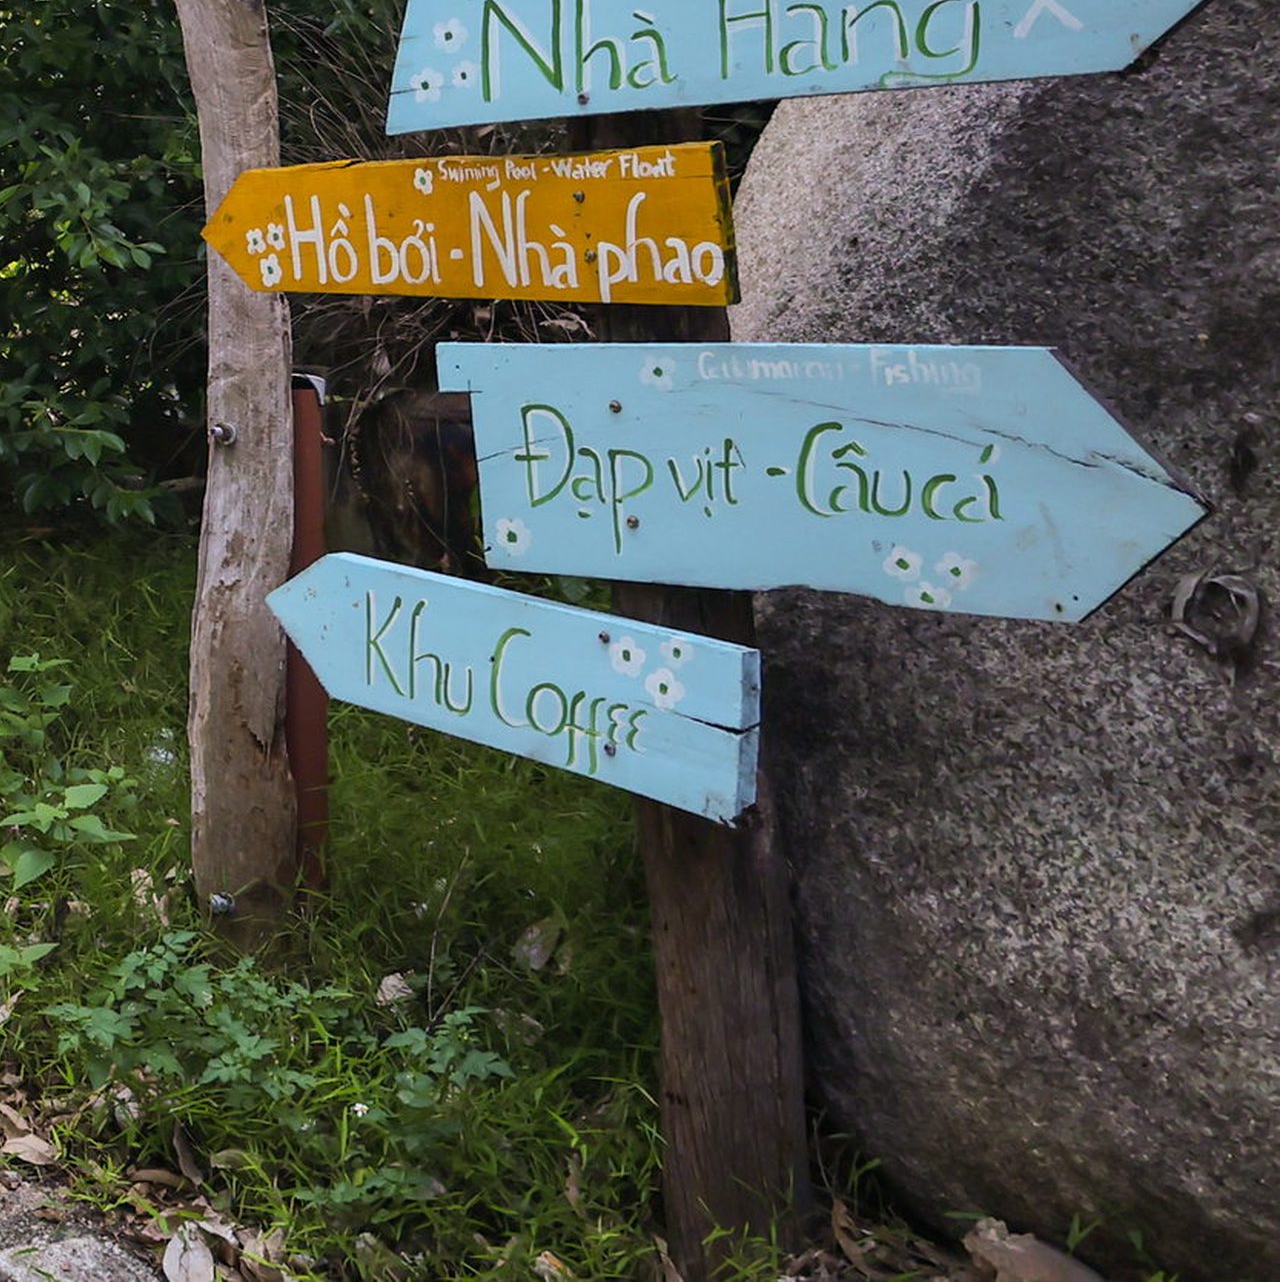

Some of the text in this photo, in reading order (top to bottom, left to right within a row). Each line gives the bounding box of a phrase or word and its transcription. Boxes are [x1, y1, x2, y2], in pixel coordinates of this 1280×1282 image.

[504, 158, 538, 181] Pool
[550, 157, 614, 180] Water
[618, 149, 677, 179] Float
[283, 192, 358, 287] Hồ
[467, 188, 580, 289] Nhà
[594, 190, 726, 304] phao
[869, 346, 984, 398] Fishing
[512, 402, 654, 556] Đạp
[669, 436, 746, 519] vịt
[795, 420, 912, 519] Câu
[364, 588, 649, 776] Khu Coffee
